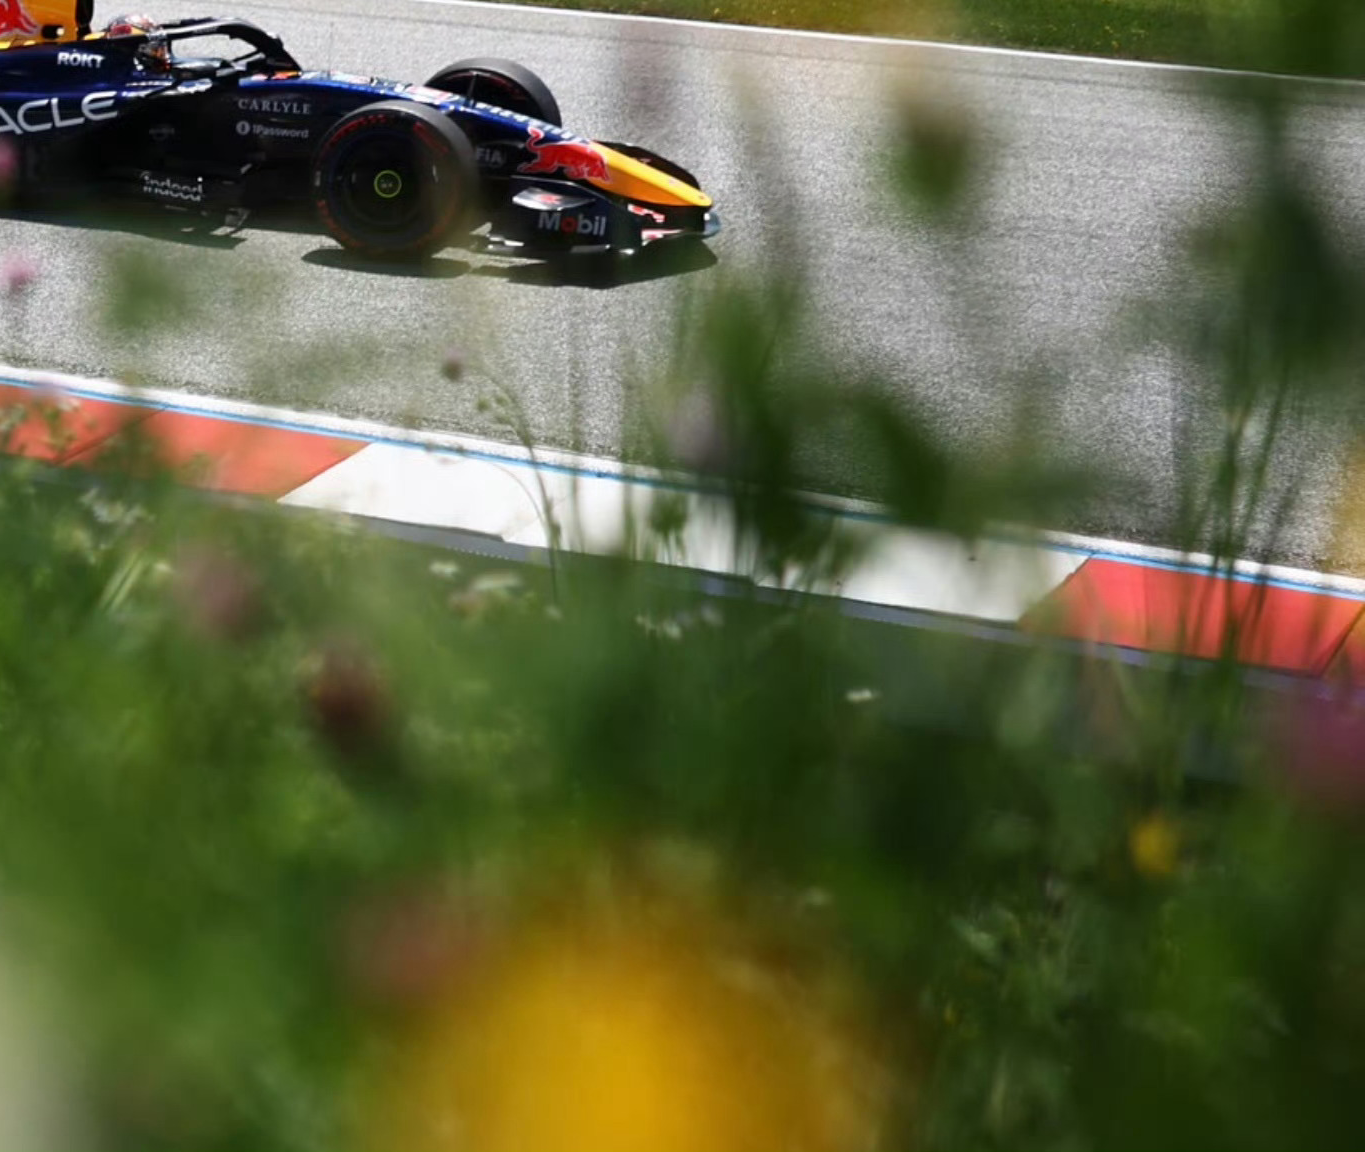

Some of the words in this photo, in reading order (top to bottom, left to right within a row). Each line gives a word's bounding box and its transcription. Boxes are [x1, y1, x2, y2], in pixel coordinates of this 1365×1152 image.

[238, 99, 312, 115] CARLYLE
[252, 123, 310, 139] 1Password
[538, 211, 607, 237] Mobil
